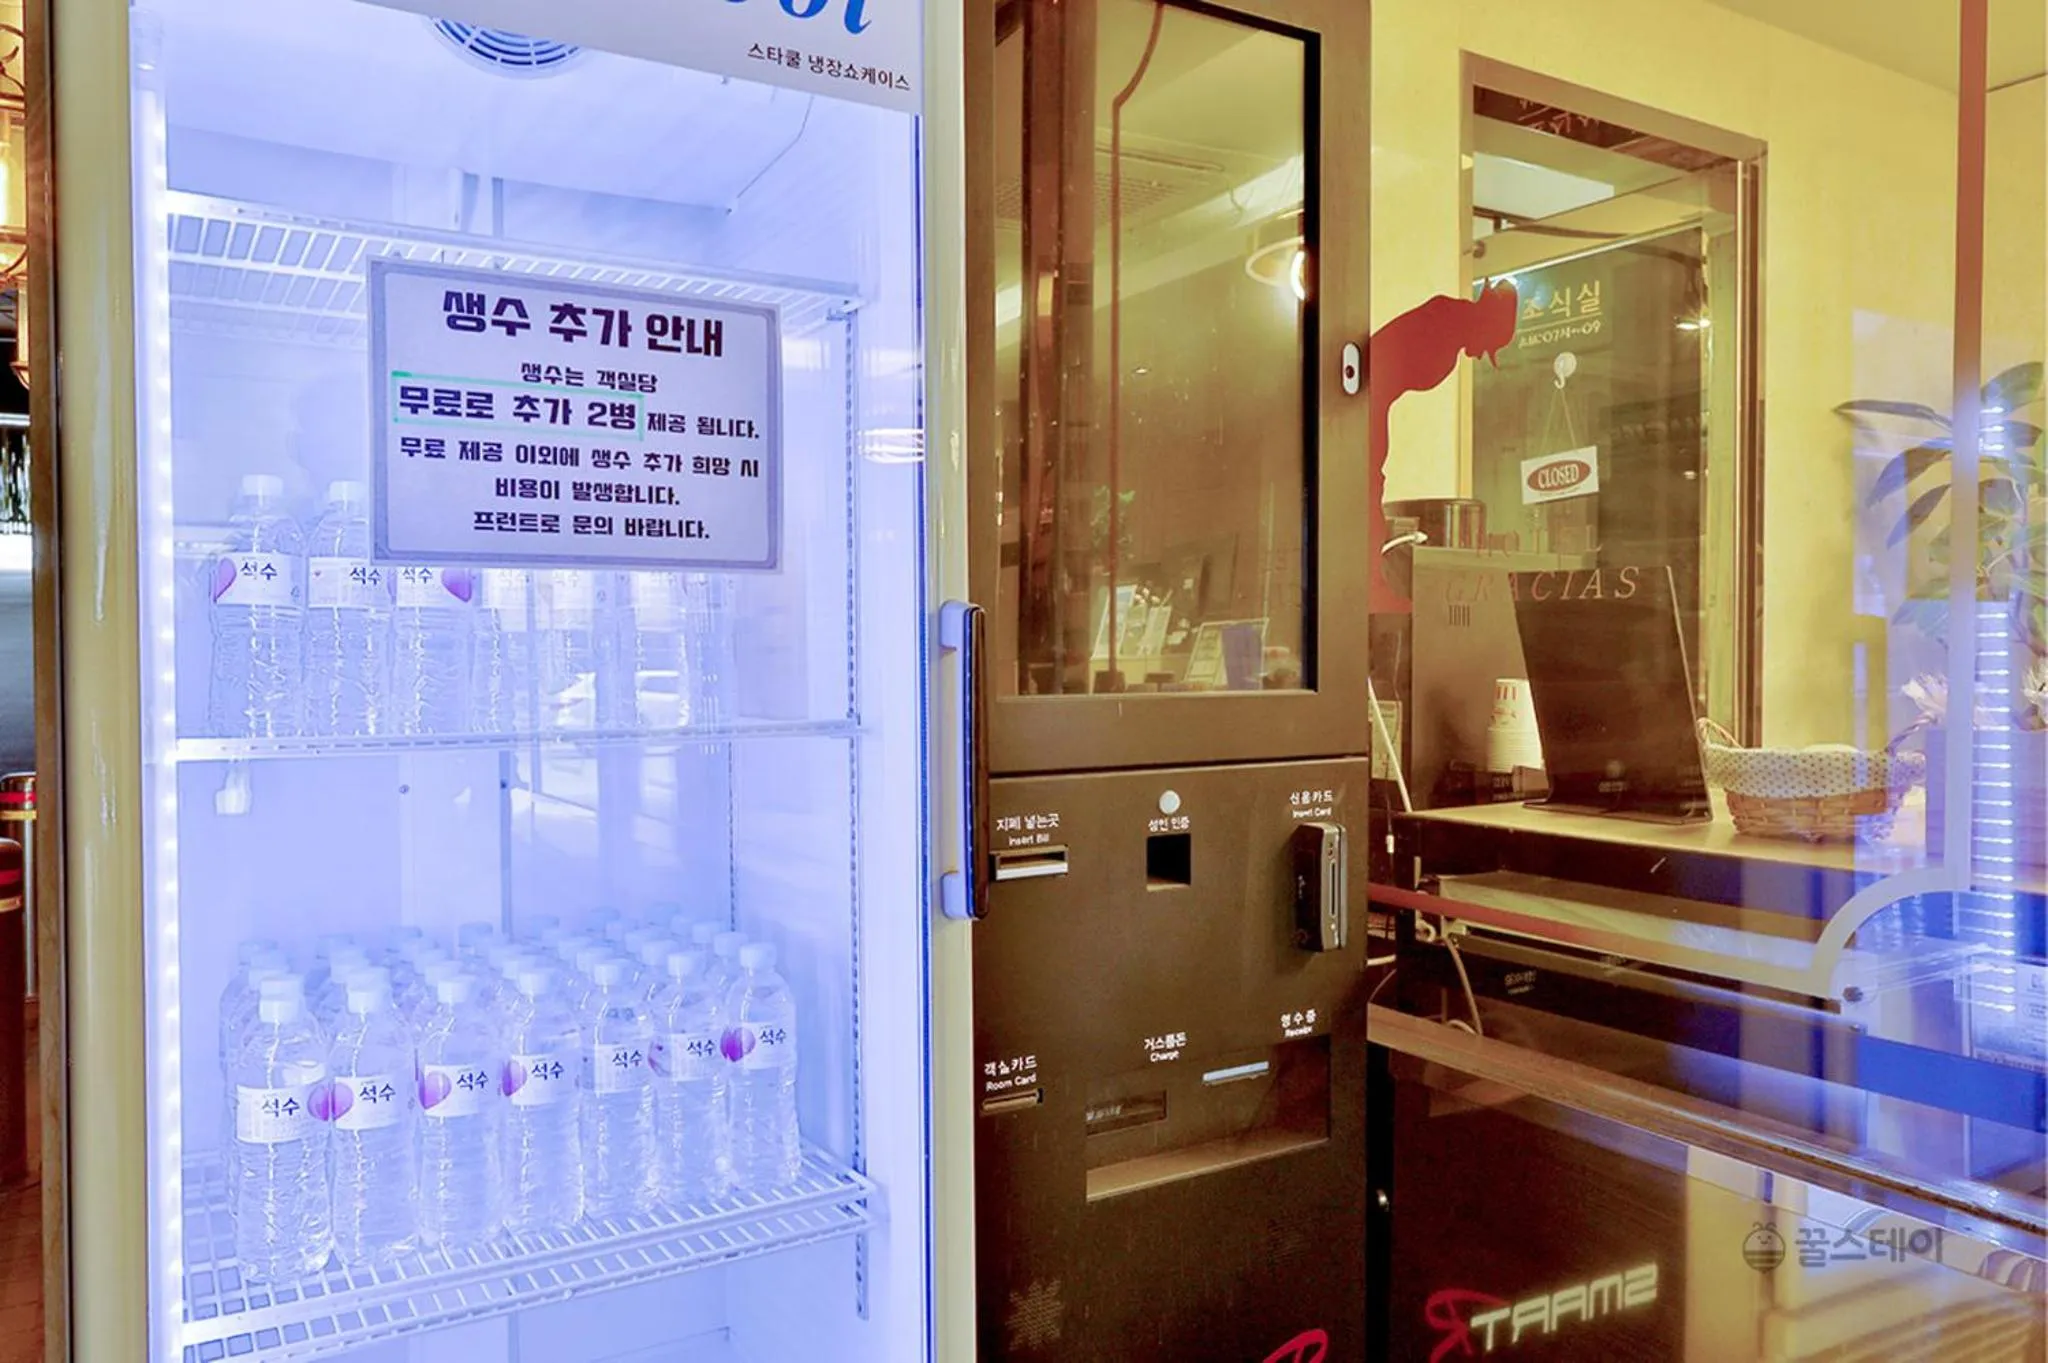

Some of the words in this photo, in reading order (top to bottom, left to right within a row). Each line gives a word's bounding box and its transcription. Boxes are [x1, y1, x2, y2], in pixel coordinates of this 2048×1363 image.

[747, 43, 802, 69] 스타쿨
[807, 54, 911, 91] 냉장쇼케이스
[443, 289, 531, 337] 생수
[549, 302, 632, 348] 추가
[646, 314, 723, 357] 안내
[520, 362, 585, 388] 생수는
[596, 370, 658, 393] 객실당
[399, 385, 494, 421] 무료로
[512, 394, 573, 425] 추가
[587, 401, 637, 431] 2병
[647, 413, 687, 434] 제공
[696, 416, 761, 440] 됩니다.
[400, 437, 447, 462] 무료
[458, 440, 503, 463] 제공
[515, 444, 580, 467] 이외에
[590, 448, 632, 470] 생수
[643, 452, 683, 473] 추가
[692, 456, 731, 477] 희망
[740, 459, 760, 478] 시
[1537, 463, 1580, 489] CLOSED
[495, 477, 561, 501] 비용이
[571, 480, 681, 506] 발생합니다.
[473, 511, 561, 533] 프런트로
[572, 514, 614, 536] 문의
[623, 518, 711, 540] 바랍니다.
[240, 562, 278, 581] 석수
[349, 567, 381, 587] 석수
[402, 566, 434, 584] 석수
[1446, 565, 1640, 601] GRACIAS
[758, 1026, 788, 1046] 석수
[686, 1039, 716, 1058] 석수
[612, 1050, 642, 1069] 석수
[456, 1070, 489, 1091] 석수
[531, 1060, 565, 1081] 석수
[359, 1083, 396, 1103] 석수
[985, 1080, 1014, 1092] Room
[1014, 1073, 1037, 1087] Card
[260, 1097, 301, 1118] 석수
